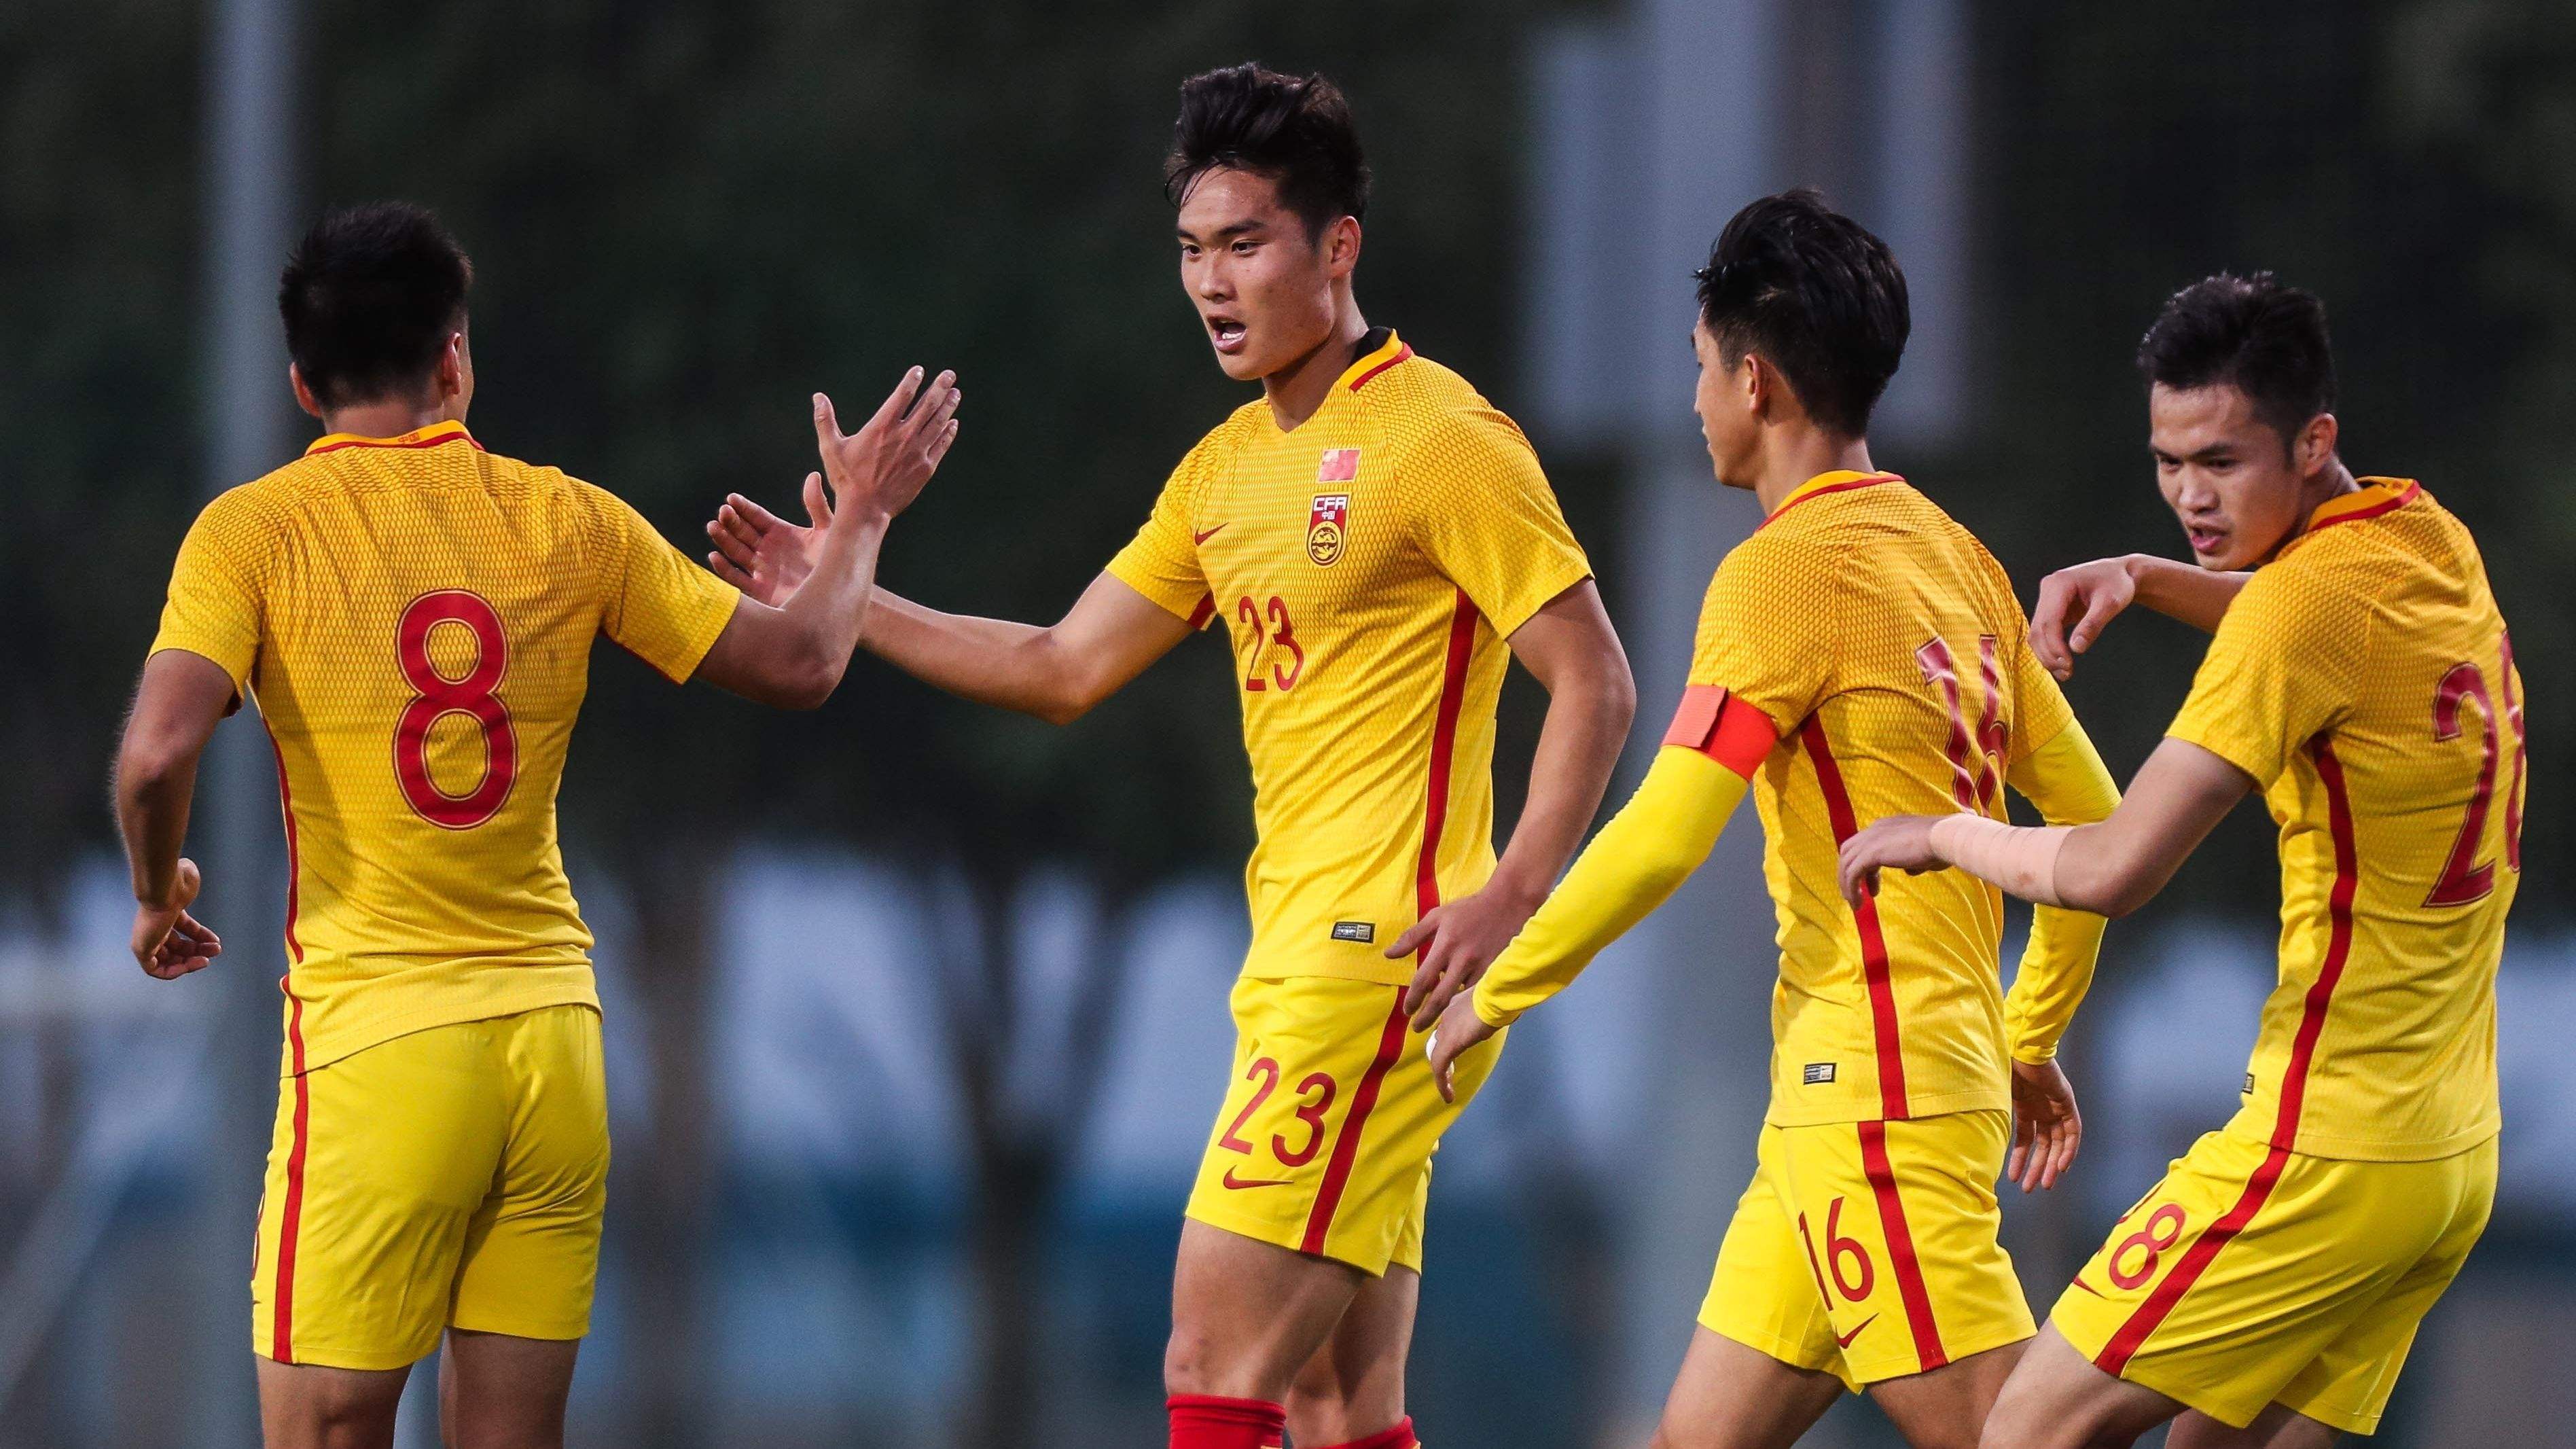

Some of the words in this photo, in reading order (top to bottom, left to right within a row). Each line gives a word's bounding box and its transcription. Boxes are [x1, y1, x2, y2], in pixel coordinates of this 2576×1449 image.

[1313, 497, 1348, 511] CFA
[1238, 596, 1304, 692] 23
[391, 588, 519, 831] 8
[1218, 1057, 1337, 1167] 23
[1799, 1196, 1874, 1312] 16
[2097, 1203, 2186, 1290] 8
